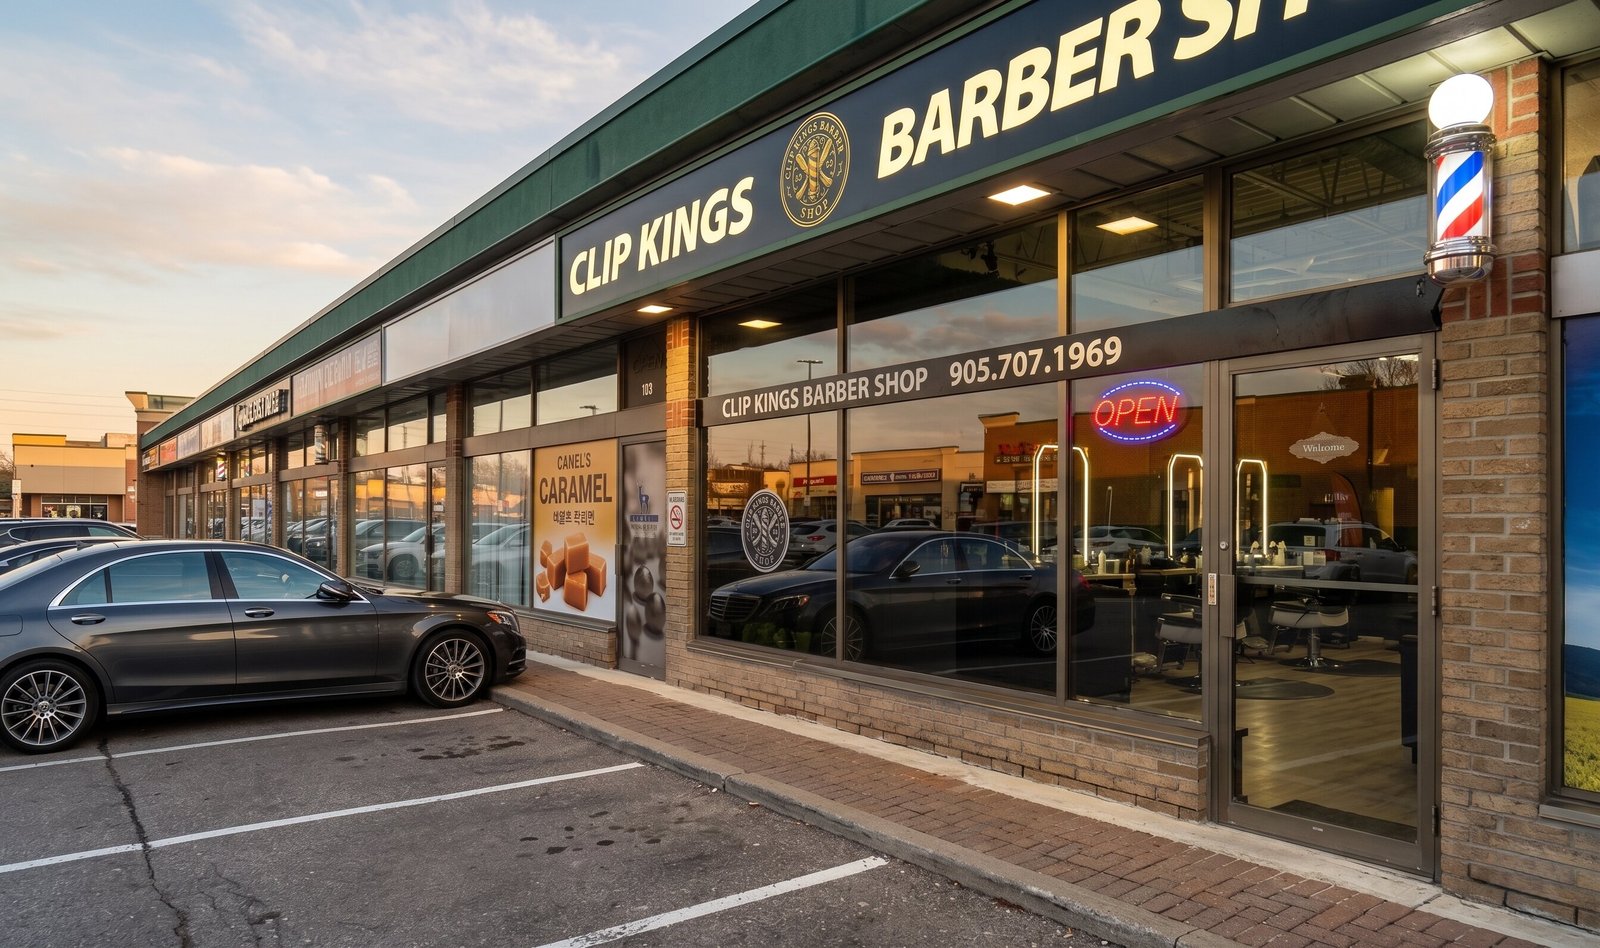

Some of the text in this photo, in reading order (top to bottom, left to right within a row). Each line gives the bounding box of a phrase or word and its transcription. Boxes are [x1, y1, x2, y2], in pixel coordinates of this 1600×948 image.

[569, 232, 632, 296] CLIP
[637, 176, 754, 272] KINGS
[877, 0, 1162, 180] BARBER
[785, 150, 796, 180] CLIP
[793, 121, 818, 151] KINGS
[800, 198, 828, 219] SHOP
[641, 382, 653, 396] 103
[721, 335, 1123, 418] CLIP KINGS BARBER SHOP 905.707.1969
[1094, 395, 1178, 427] OPEN
[557, 452, 591, 470] CANEL'S
[539, 473, 613, 504] CARAMEL
